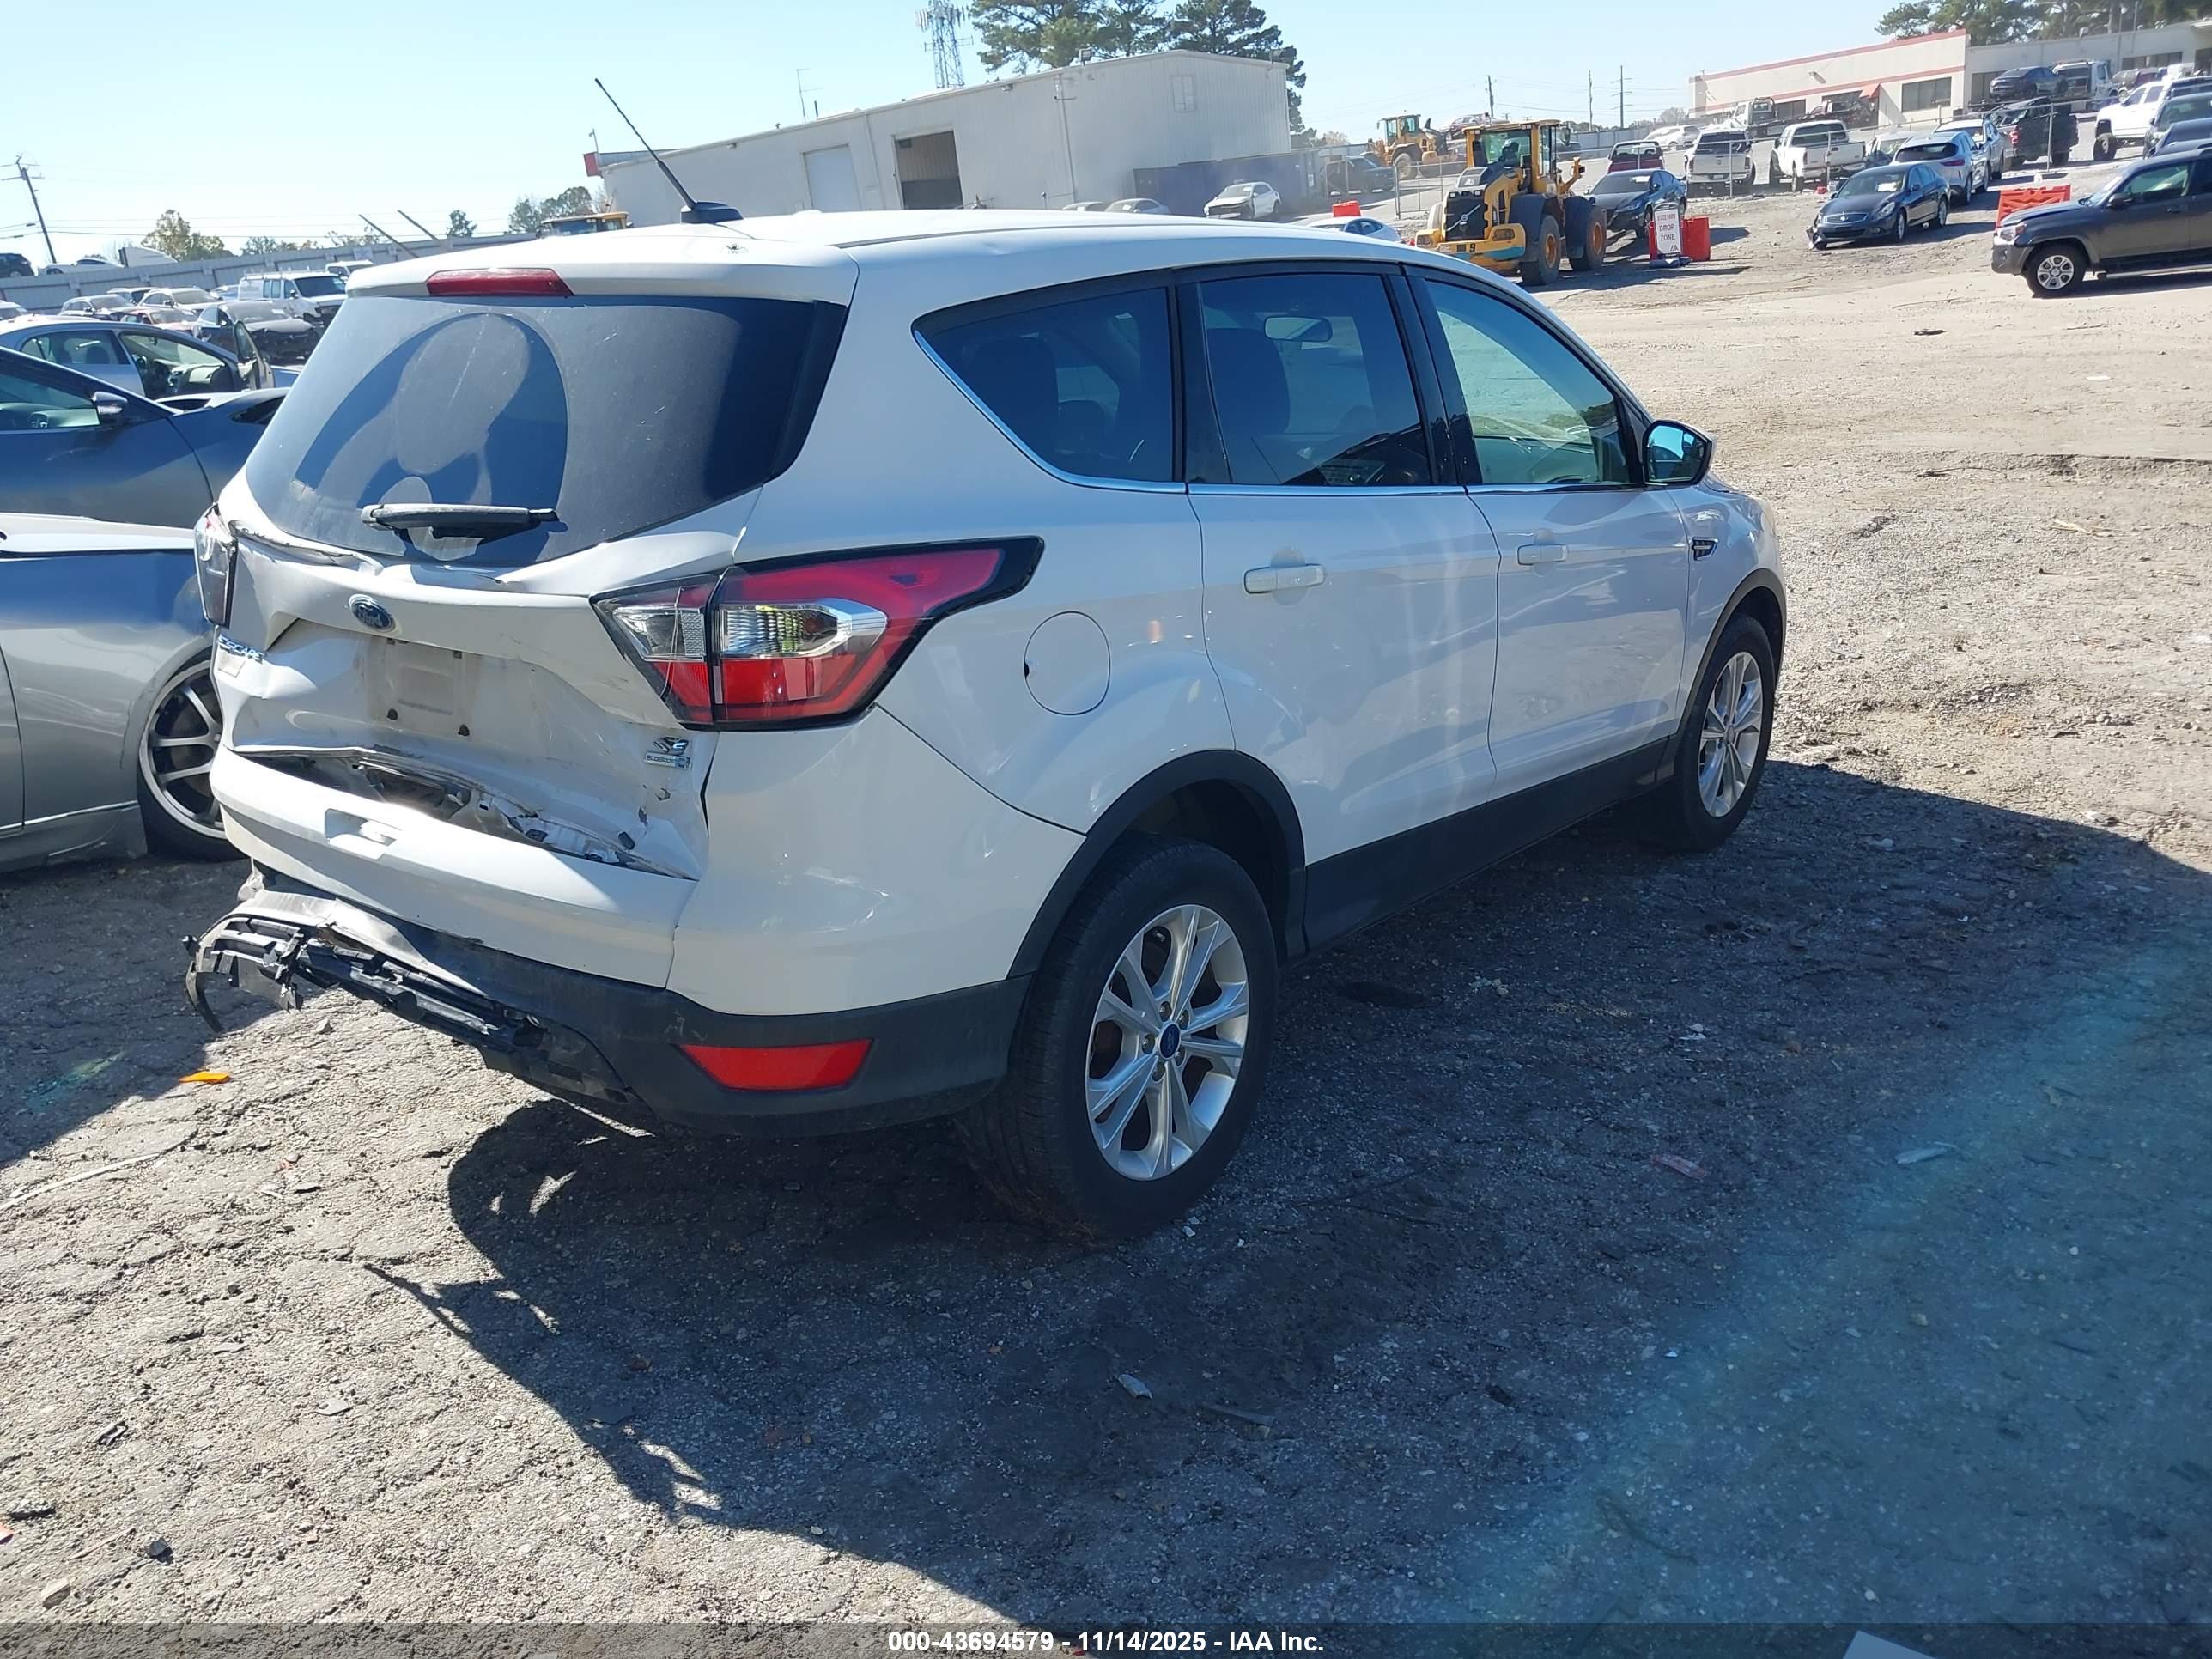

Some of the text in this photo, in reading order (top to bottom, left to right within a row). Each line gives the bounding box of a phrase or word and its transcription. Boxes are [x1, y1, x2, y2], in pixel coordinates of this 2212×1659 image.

[1659, 223, 1674, 232] DROP
[1470, 243, 1475, 252] 9
[217, 635, 265, 662] ESCAPE
